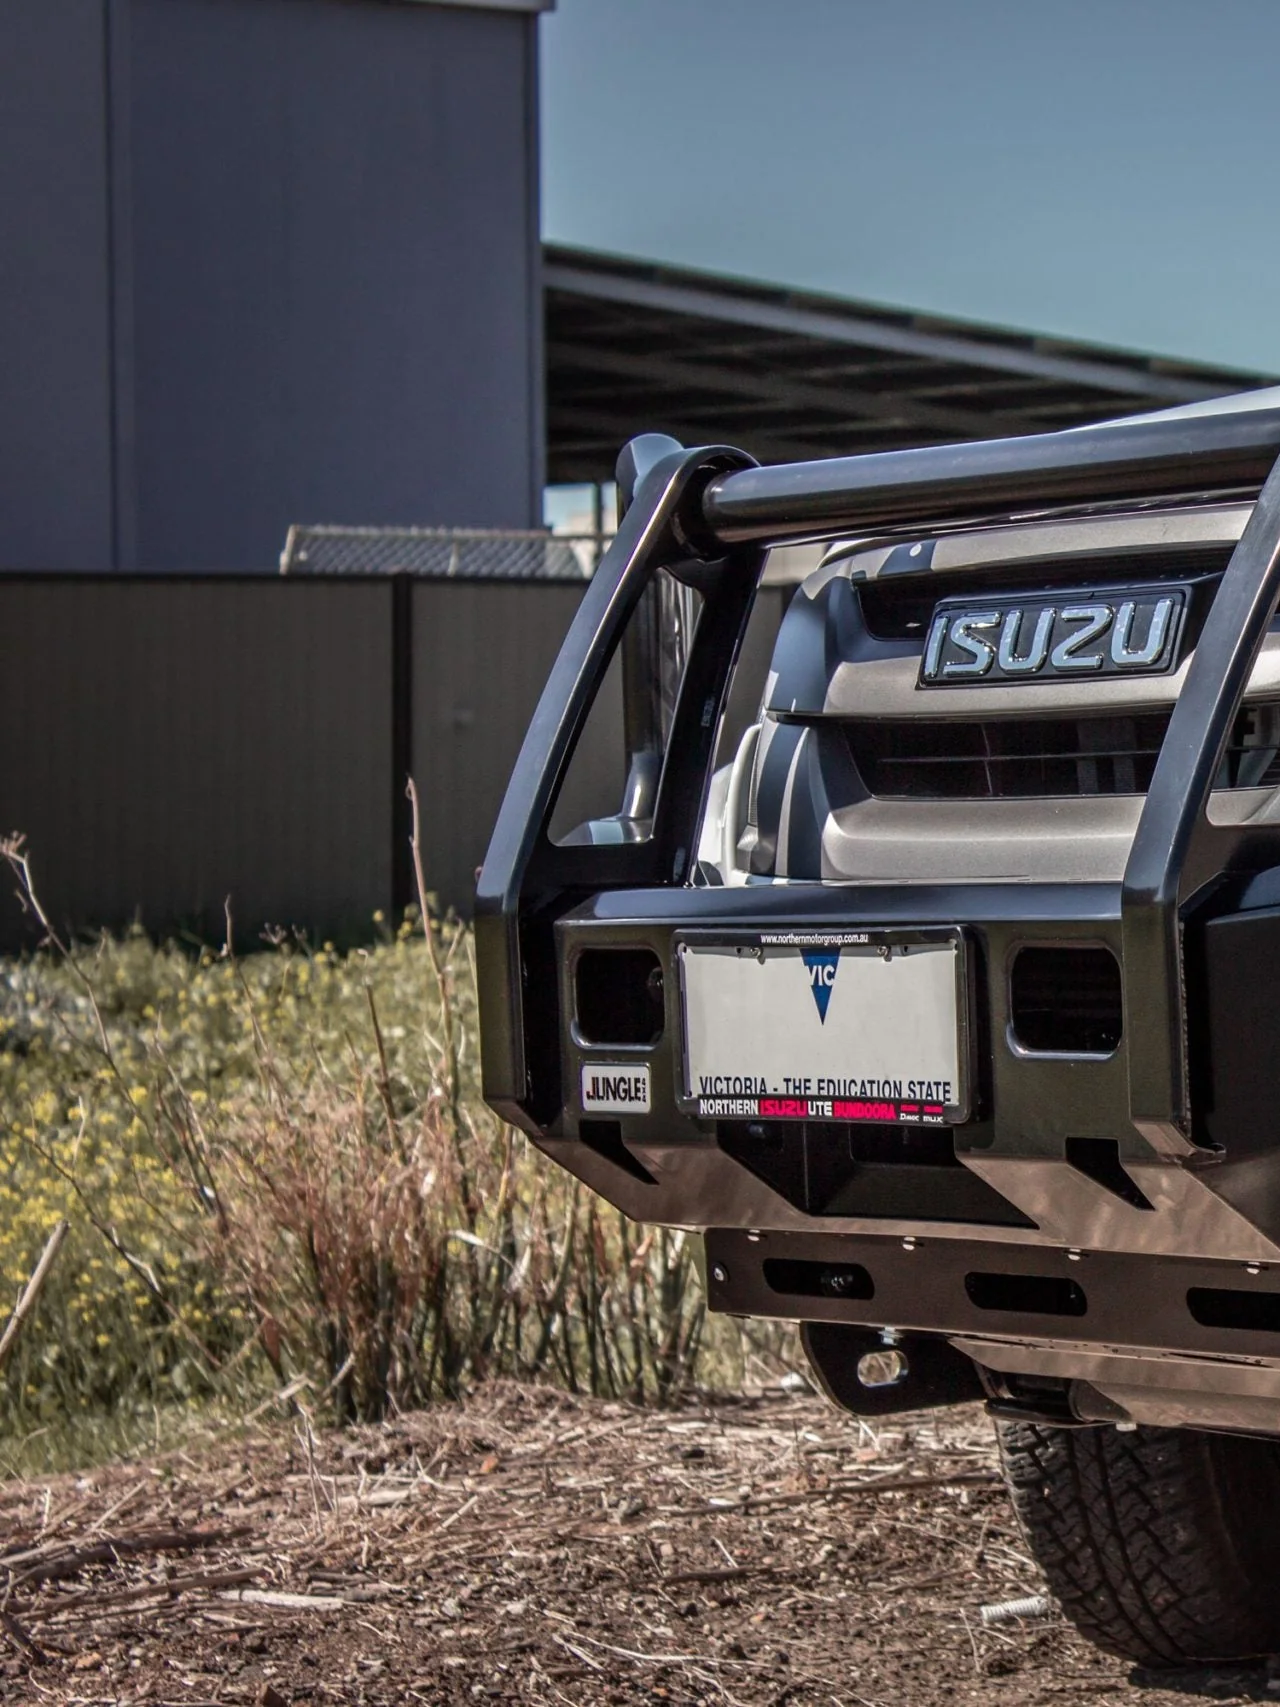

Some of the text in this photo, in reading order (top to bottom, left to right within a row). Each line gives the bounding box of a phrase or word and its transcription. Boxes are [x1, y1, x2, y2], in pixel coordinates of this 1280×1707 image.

[924, 599, 1175, 679] ISUZU
[760, 933, 869, 946] www.northernmotorgroup.com.au
[806, 964, 835, 986] VIC
[586, 1076, 641, 1102] JUNGLE
[699, 1076, 767, 1095] VICTORIA
[783, 1078, 811, 1095] THE
[817, 1079, 902, 1098] EDUCATION
[907, 1080, 952, 1103] STATE
[699, 1099, 759, 1115] NORTHERN
[760, 1100, 807, 1117] ISUZU
[807, 1101, 832, 1116] UTE
[833, 1101, 897, 1119] BUNDOORA
